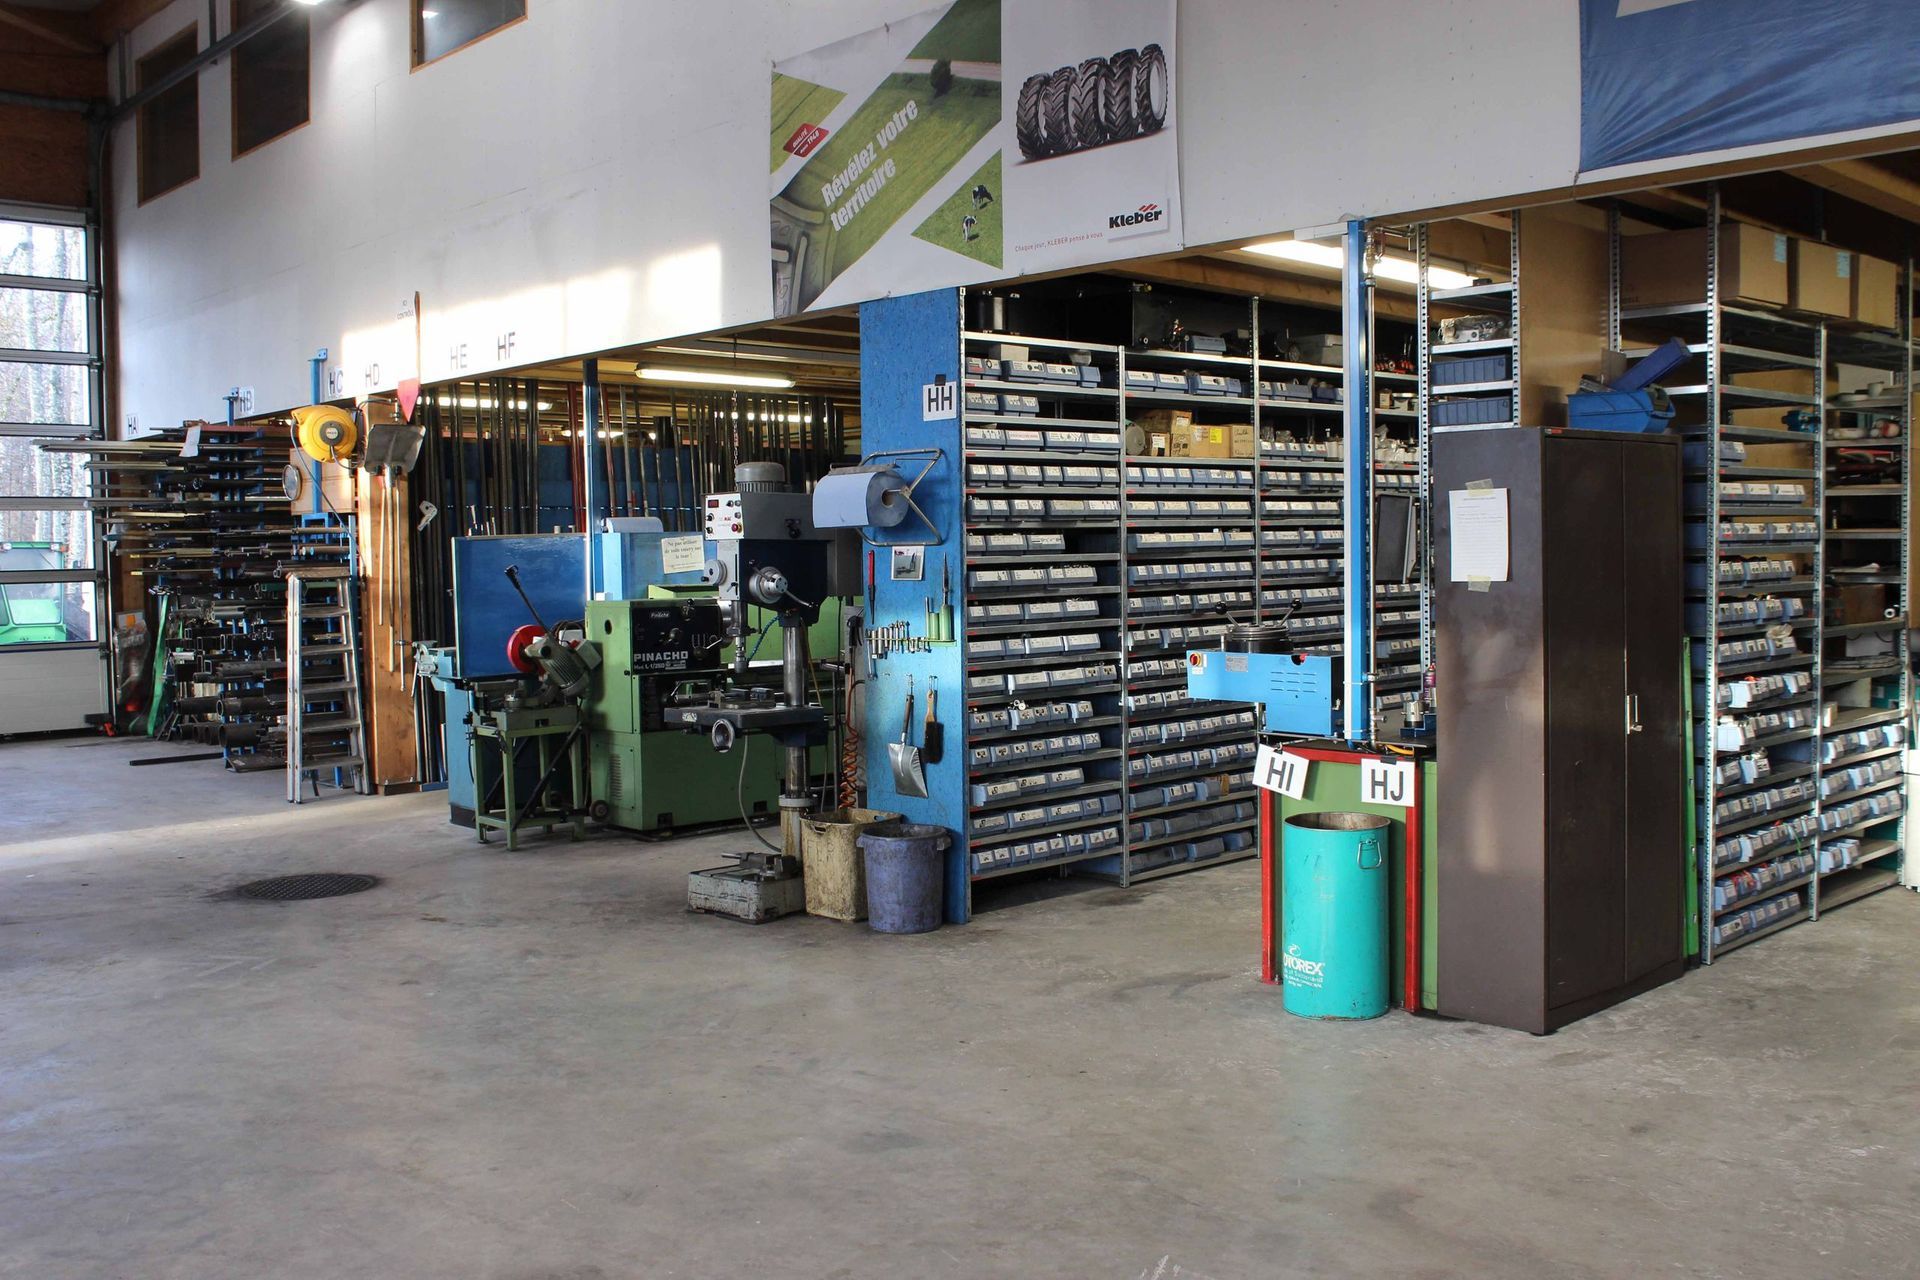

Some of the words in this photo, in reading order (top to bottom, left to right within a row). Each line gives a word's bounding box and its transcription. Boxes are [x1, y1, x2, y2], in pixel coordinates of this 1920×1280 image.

[821, 142, 877, 207] Révélez
[875, 100, 919, 149] votre
[830, 158, 896, 232] territoire
[1109, 209, 1162, 229] Kleber
[1014, 244, 1034, 252] Chaque
[1047, 237, 1069, 248] KLEBER
[1069, 234, 1086, 244] pense
[1090, 231, 1103, 239] vous
[450, 343, 468, 371] HE
[498, 331, 516, 361] HF
[329, 368, 343, 395] HC
[365, 363, 380, 387] HD
[240, 390, 253, 412] HB
[928, 385, 952, 412] HH
[127, 416, 138, 435] HA
[633, 650, 689, 662] PINACHO
[1266, 757, 1295, 792] HI
[1370, 768, 1404, 801] HJ
[1283, 952, 1325, 977] OTOREX
